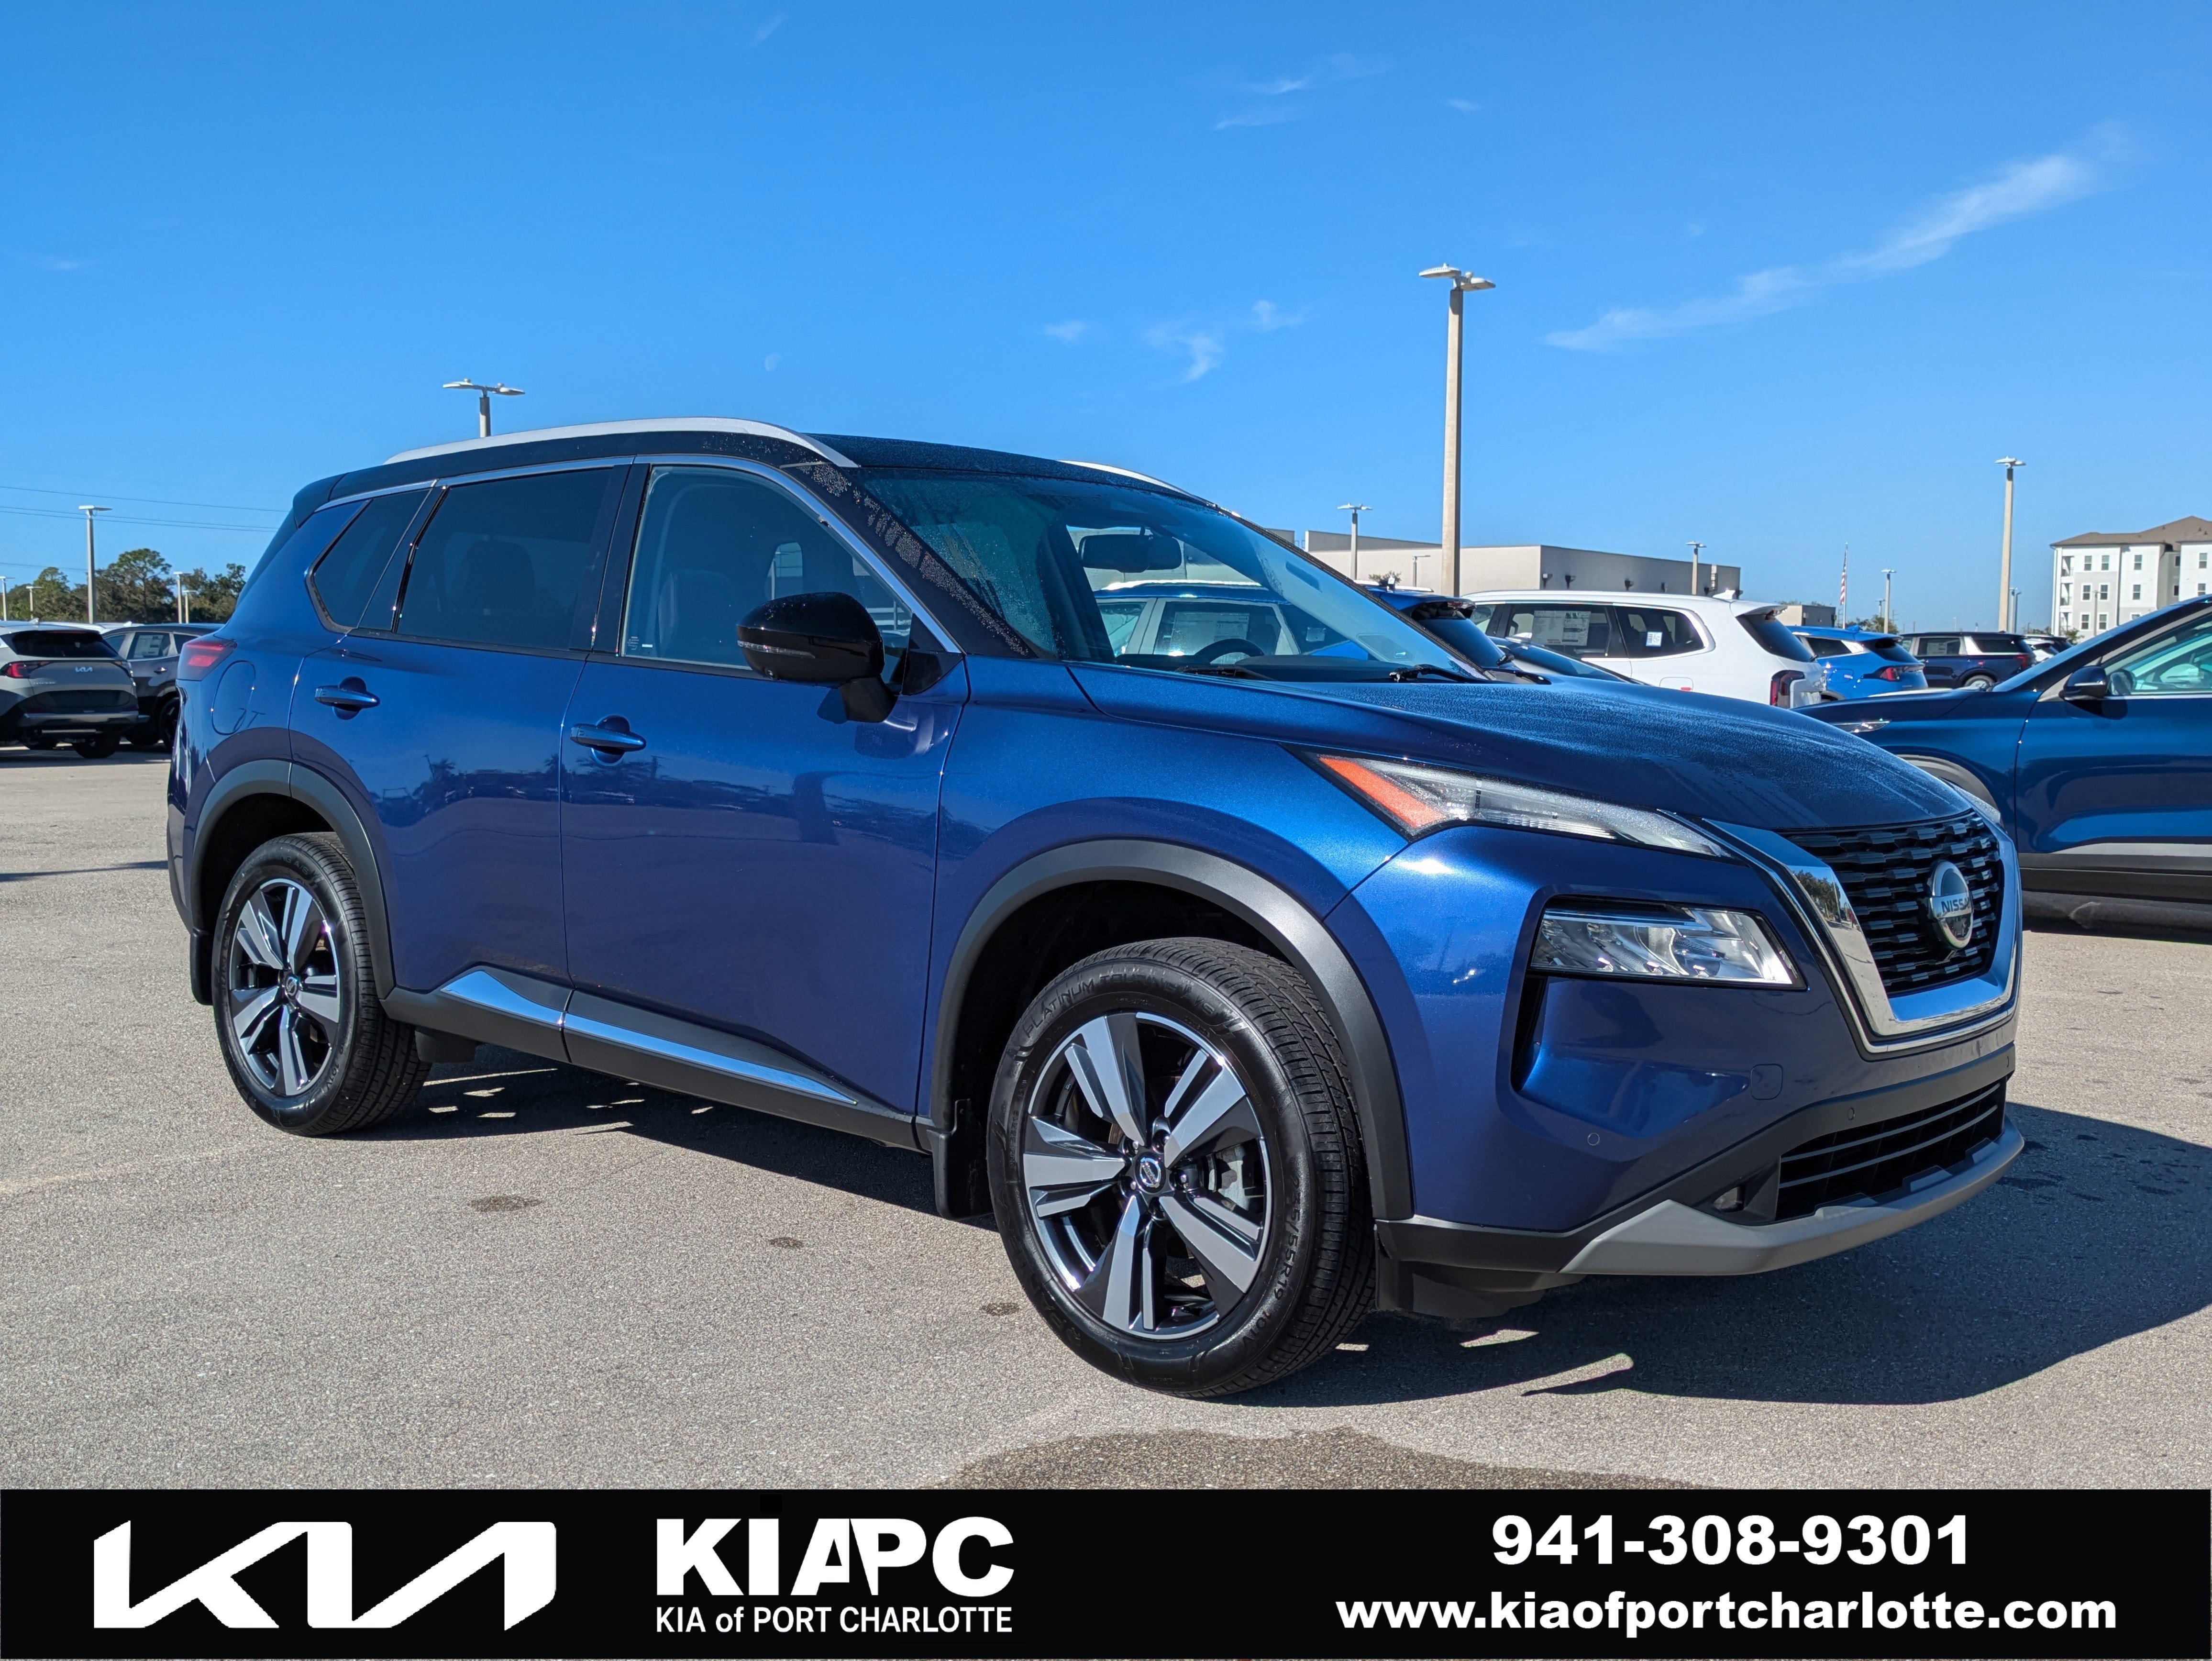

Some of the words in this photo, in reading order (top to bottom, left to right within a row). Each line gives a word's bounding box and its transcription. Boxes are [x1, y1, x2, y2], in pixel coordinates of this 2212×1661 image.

[1941, 897, 1970, 913] NISSA
[1022, 976, 1095, 1038] PLATINUM
[1273, 1175, 1301, 1301] 235/55R19
[1241, 1310, 1273, 1349] 101V
